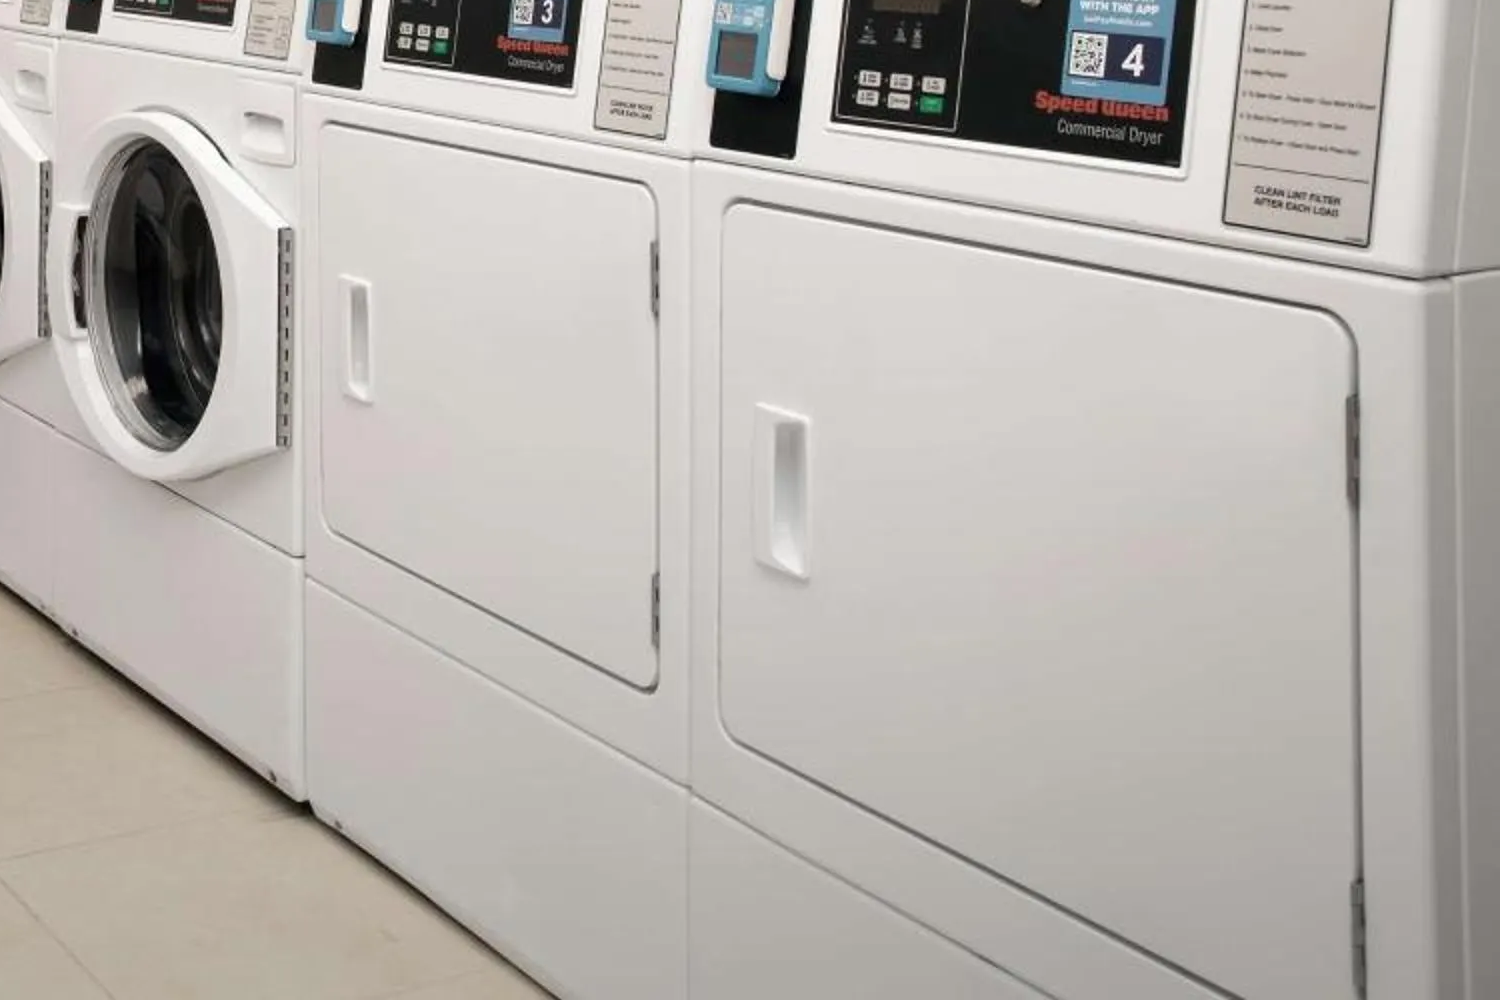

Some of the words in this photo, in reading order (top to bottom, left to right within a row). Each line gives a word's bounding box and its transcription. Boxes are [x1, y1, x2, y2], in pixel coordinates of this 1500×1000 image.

[1080, 0, 1109, 12] WITH
[1111, 2, 1133, 13] THE
[1136, 3, 1160, 15] APP
[1121, 42, 1145, 78] 4
[1034, 90, 1099, 113] Speed
[1057, 118, 1127, 141] Commercial
[1129, 126, 1164, 147] Dryer
[1253, 185, 1285, 197] CLEAN
[1309, 193, 1341, 205] FILTER
[1253, 197, 1283, 208] AFTER
[1286, 202, 1311, 212] EACH
[1313, 206, 1340, 217] LOAD
